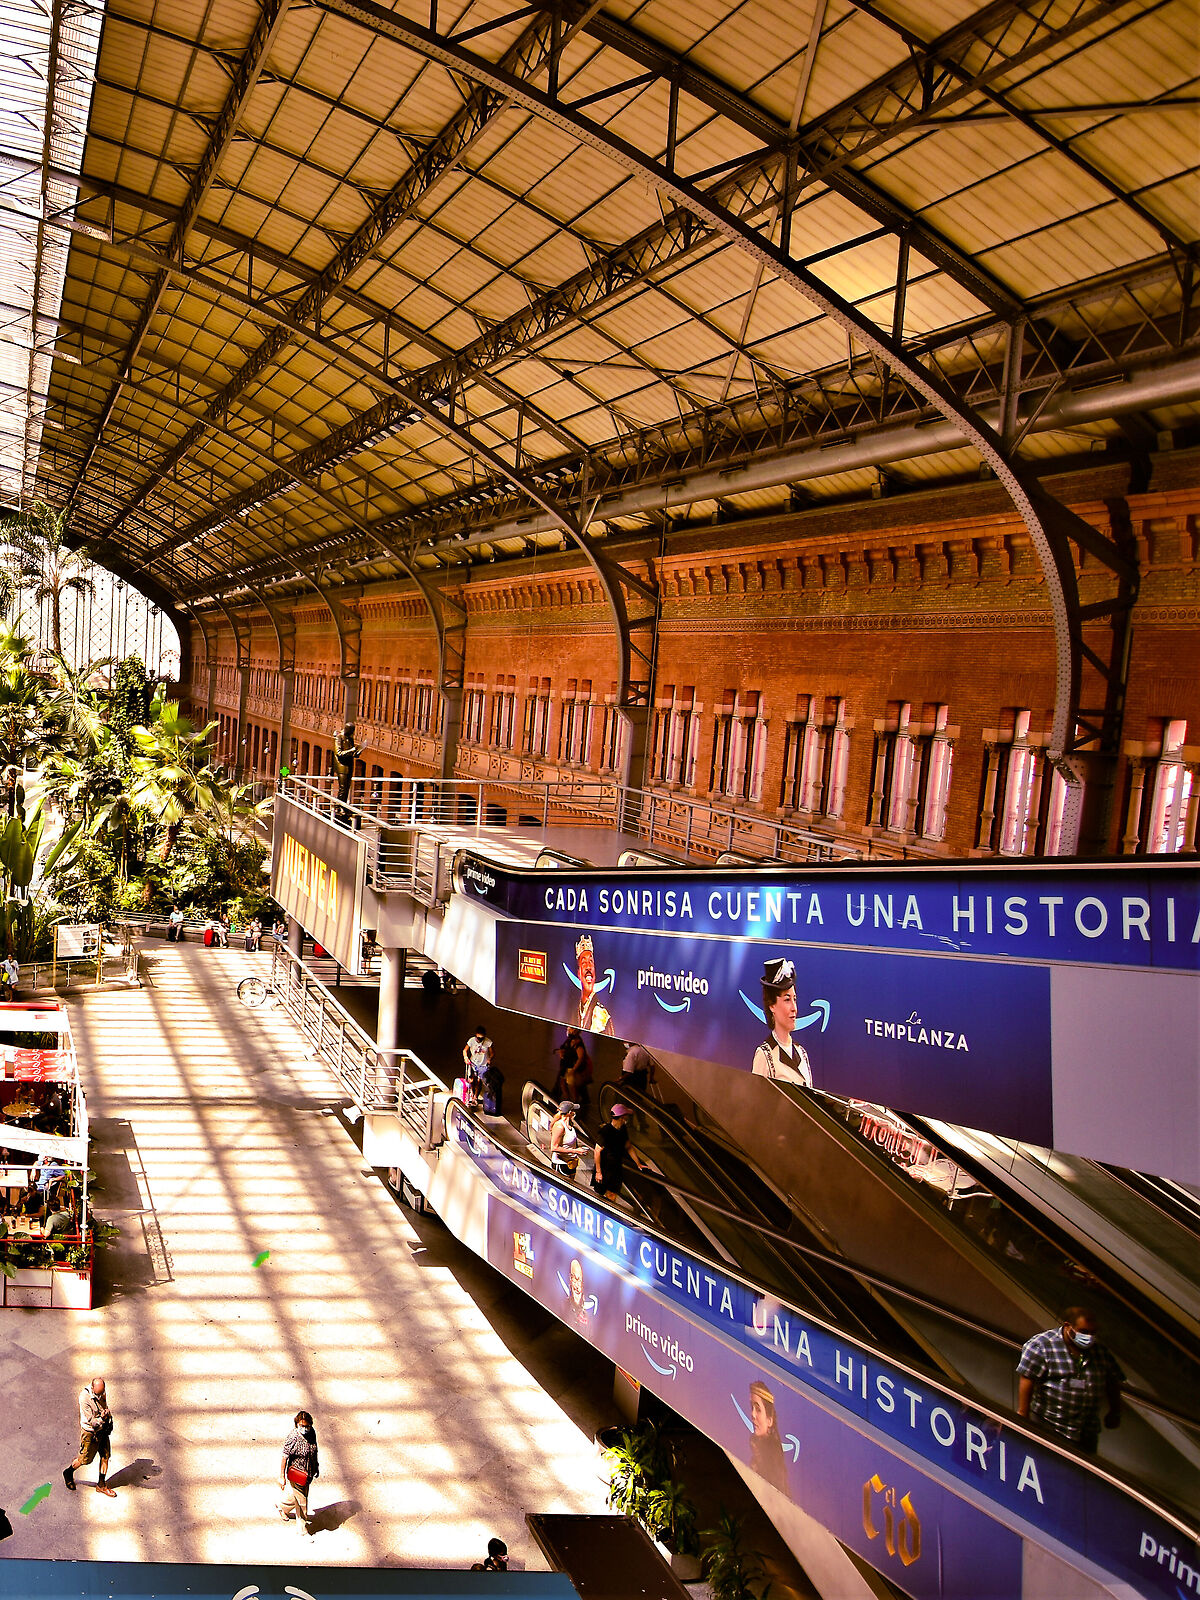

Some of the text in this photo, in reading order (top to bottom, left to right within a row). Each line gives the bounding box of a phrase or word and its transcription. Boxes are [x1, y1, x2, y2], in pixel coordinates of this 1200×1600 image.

[283, 832, 338, 923] VUELVE A
[466, 867, 495, 887] prime video
[545, 888, 589, 912] CADA
[599, 890, 693, 918] SONRISA
[708, 891, 824, 925] CUENTA
[846, 894, 923, 930] UNA
[637, 965, 709, 995] prime video
[864, 1018, 969, 1052] TEMPLANZA
[905, 1011, 922, 1025] La
[502, 1160, 1044, 1505] CADA SONRISA CUENTA UNA HISTORIA
[625, 1312, 694, 1373] prime video
